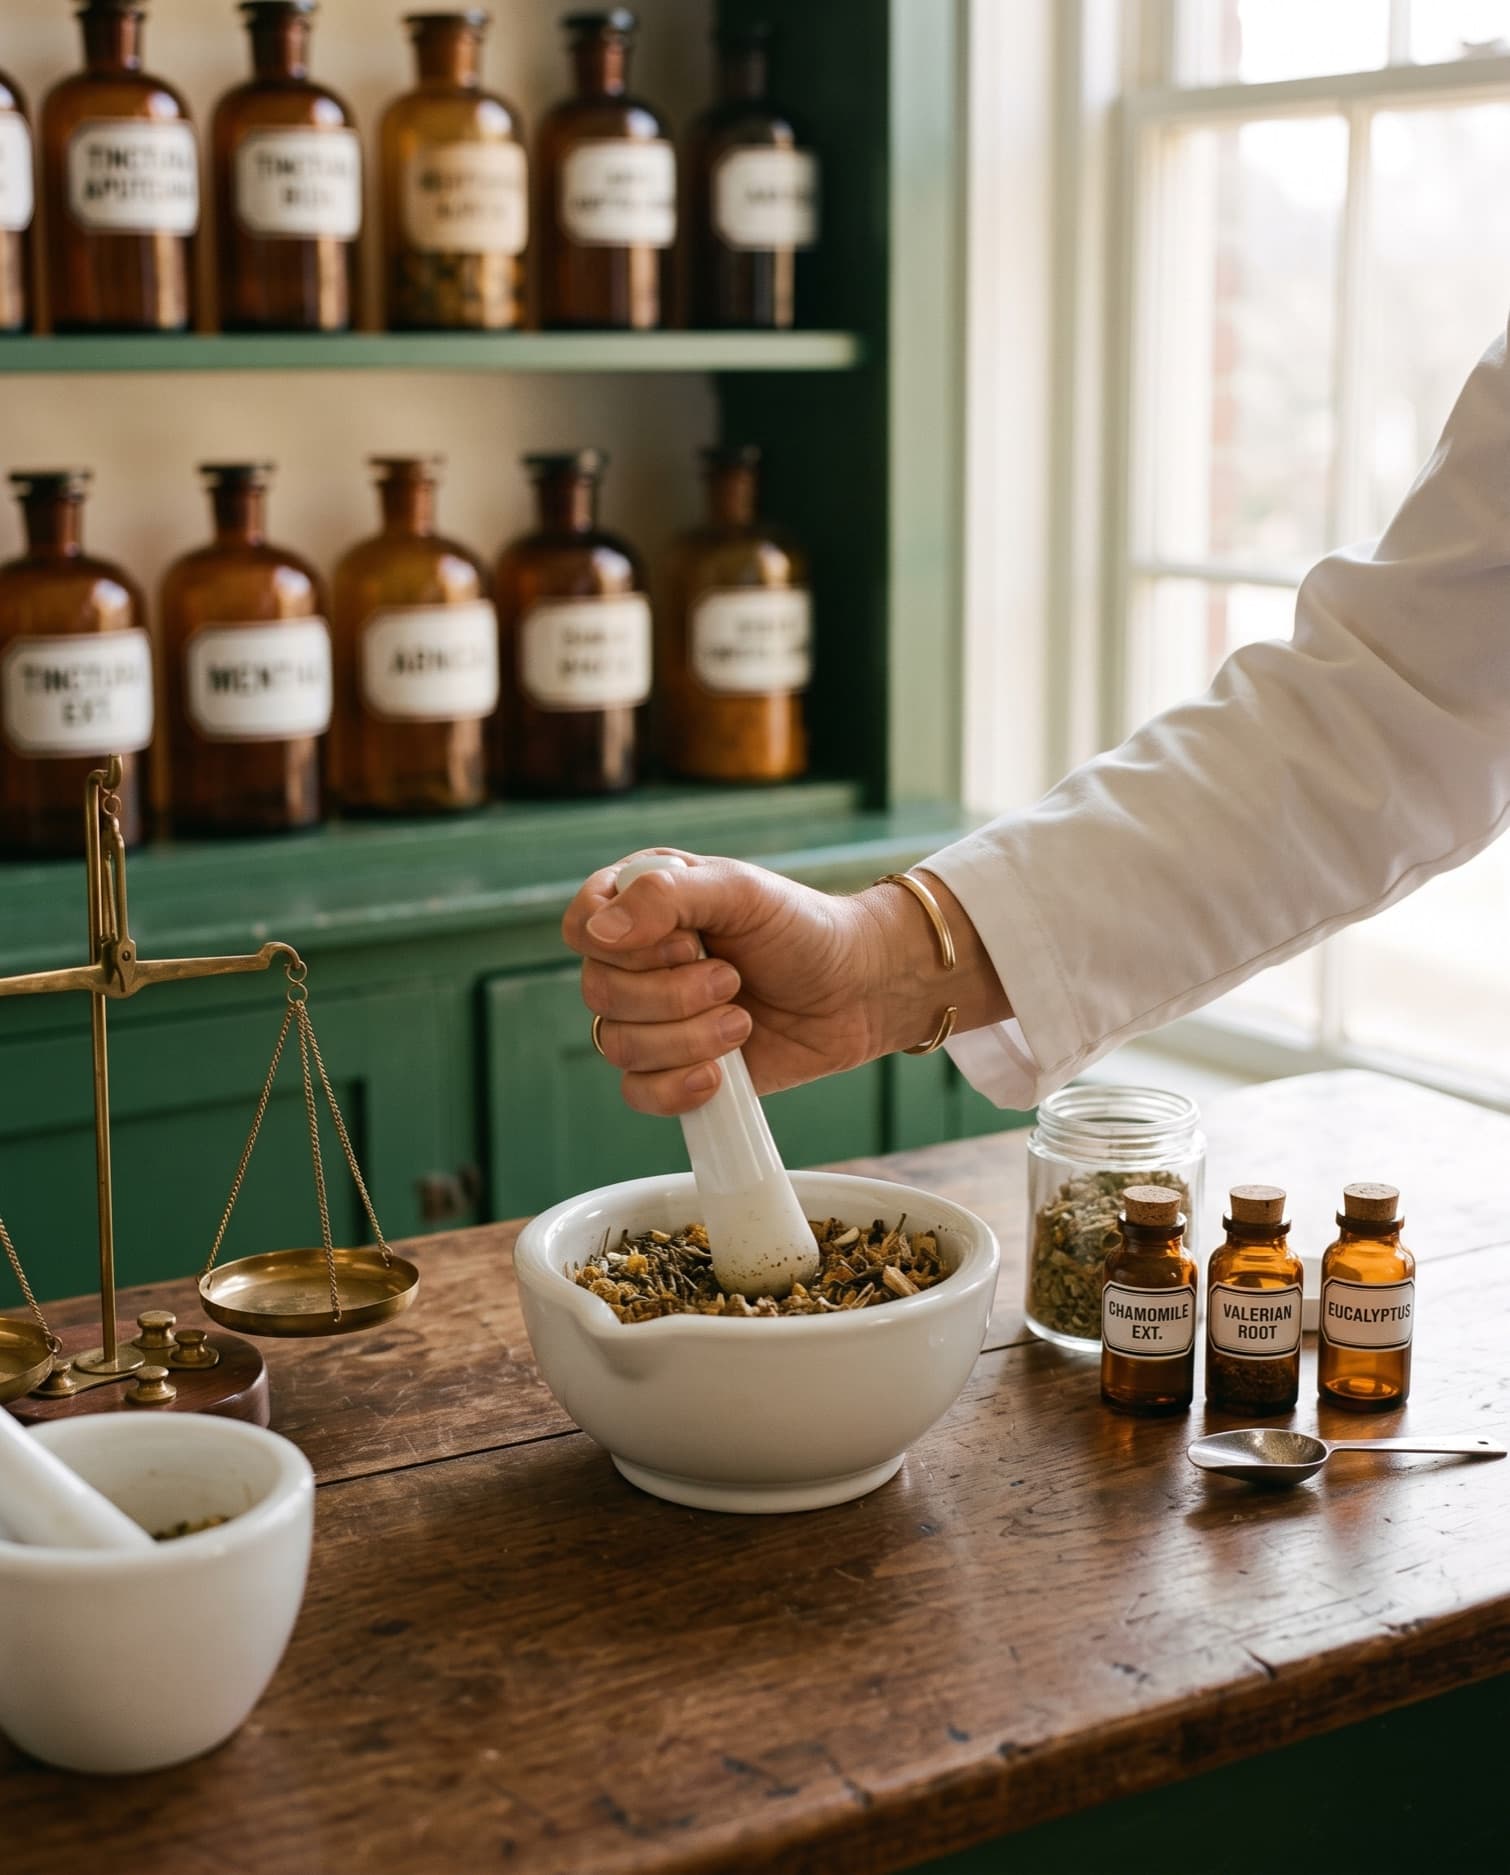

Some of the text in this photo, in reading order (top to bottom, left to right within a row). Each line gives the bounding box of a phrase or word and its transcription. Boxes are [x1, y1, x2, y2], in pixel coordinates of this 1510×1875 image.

[1109, 1301, 1189, 1322] CHAMOMILE
[1223, 1303, 1292, 1322] VALERIAN
[1328, 1302, 1411, 1323] EUCALYPTUS
[1132, 1325, 1163, 1340] EXT.
[1238, 1325, 1278, 1340] ROOT
